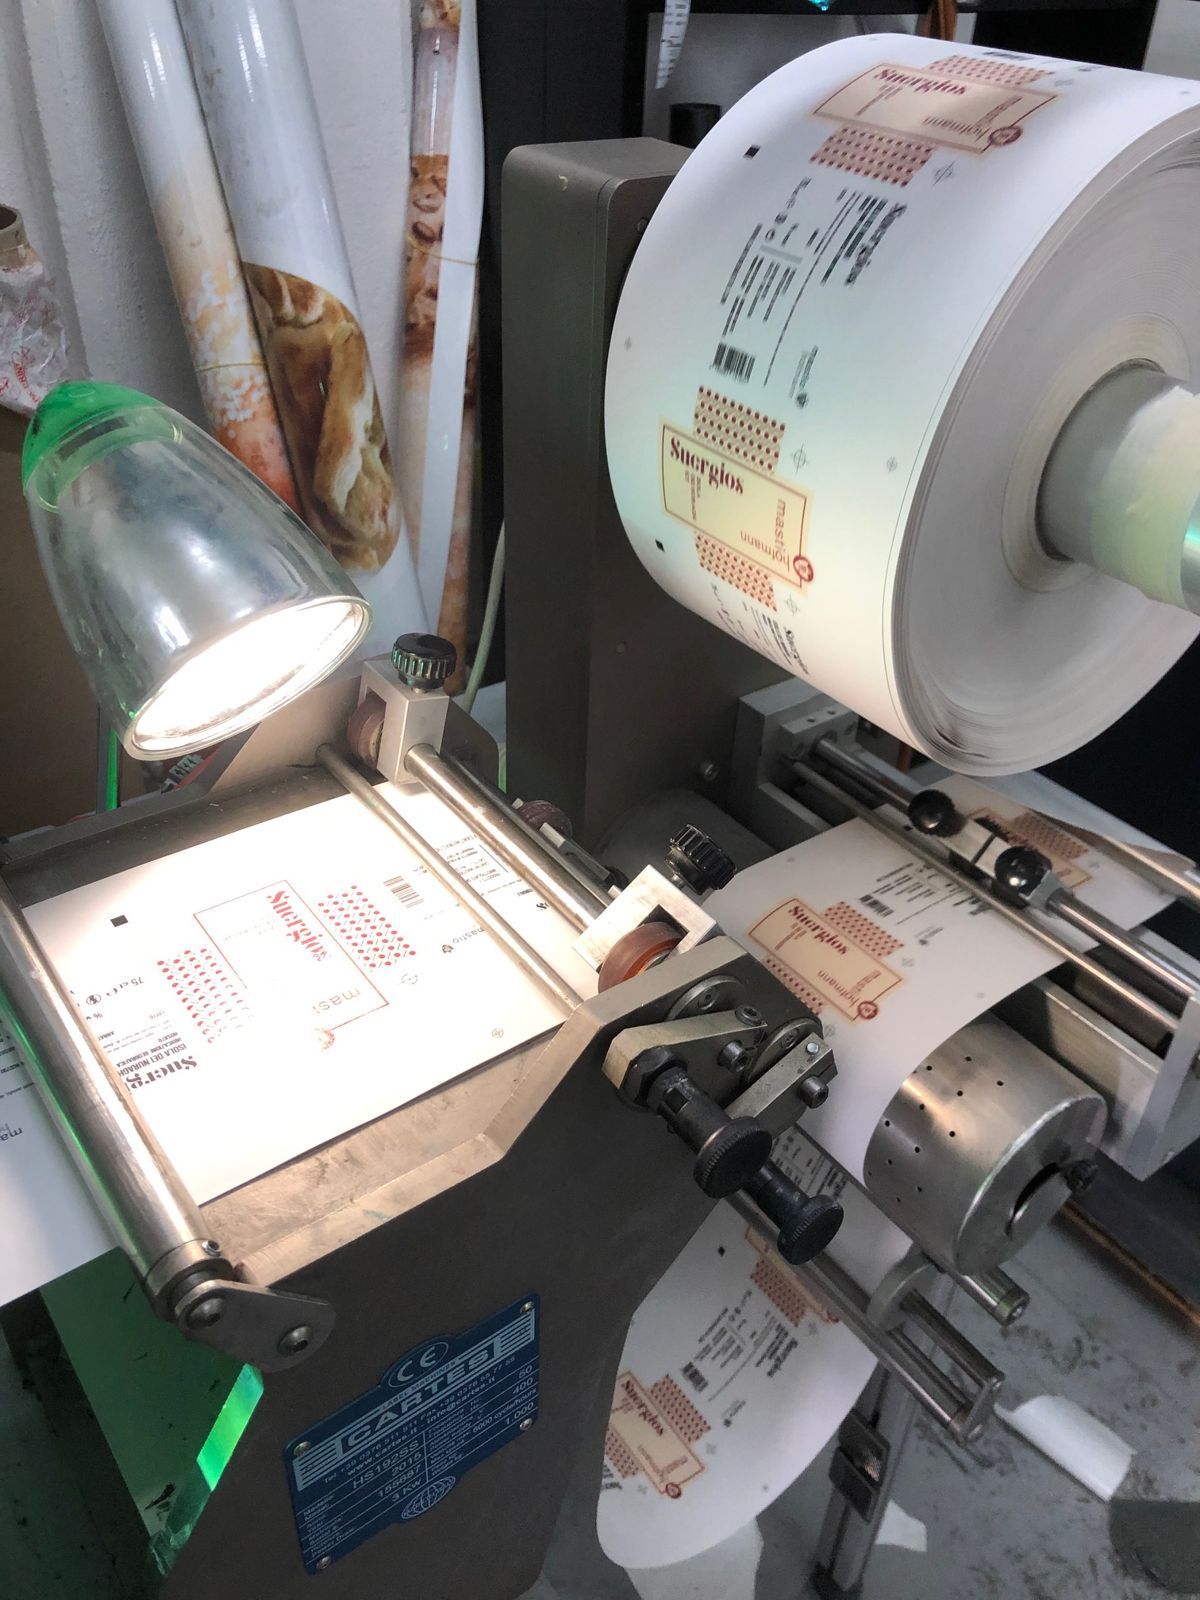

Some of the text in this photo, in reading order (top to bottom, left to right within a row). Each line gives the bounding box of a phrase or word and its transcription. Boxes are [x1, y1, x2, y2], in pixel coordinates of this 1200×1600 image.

[150, 1052, 165, 1064] DEI
[166, 1043, 187, 1057] ISOLA
[512, 1375, 532, 1396] 400
[347, 1348, 488, 1448] CARTES
